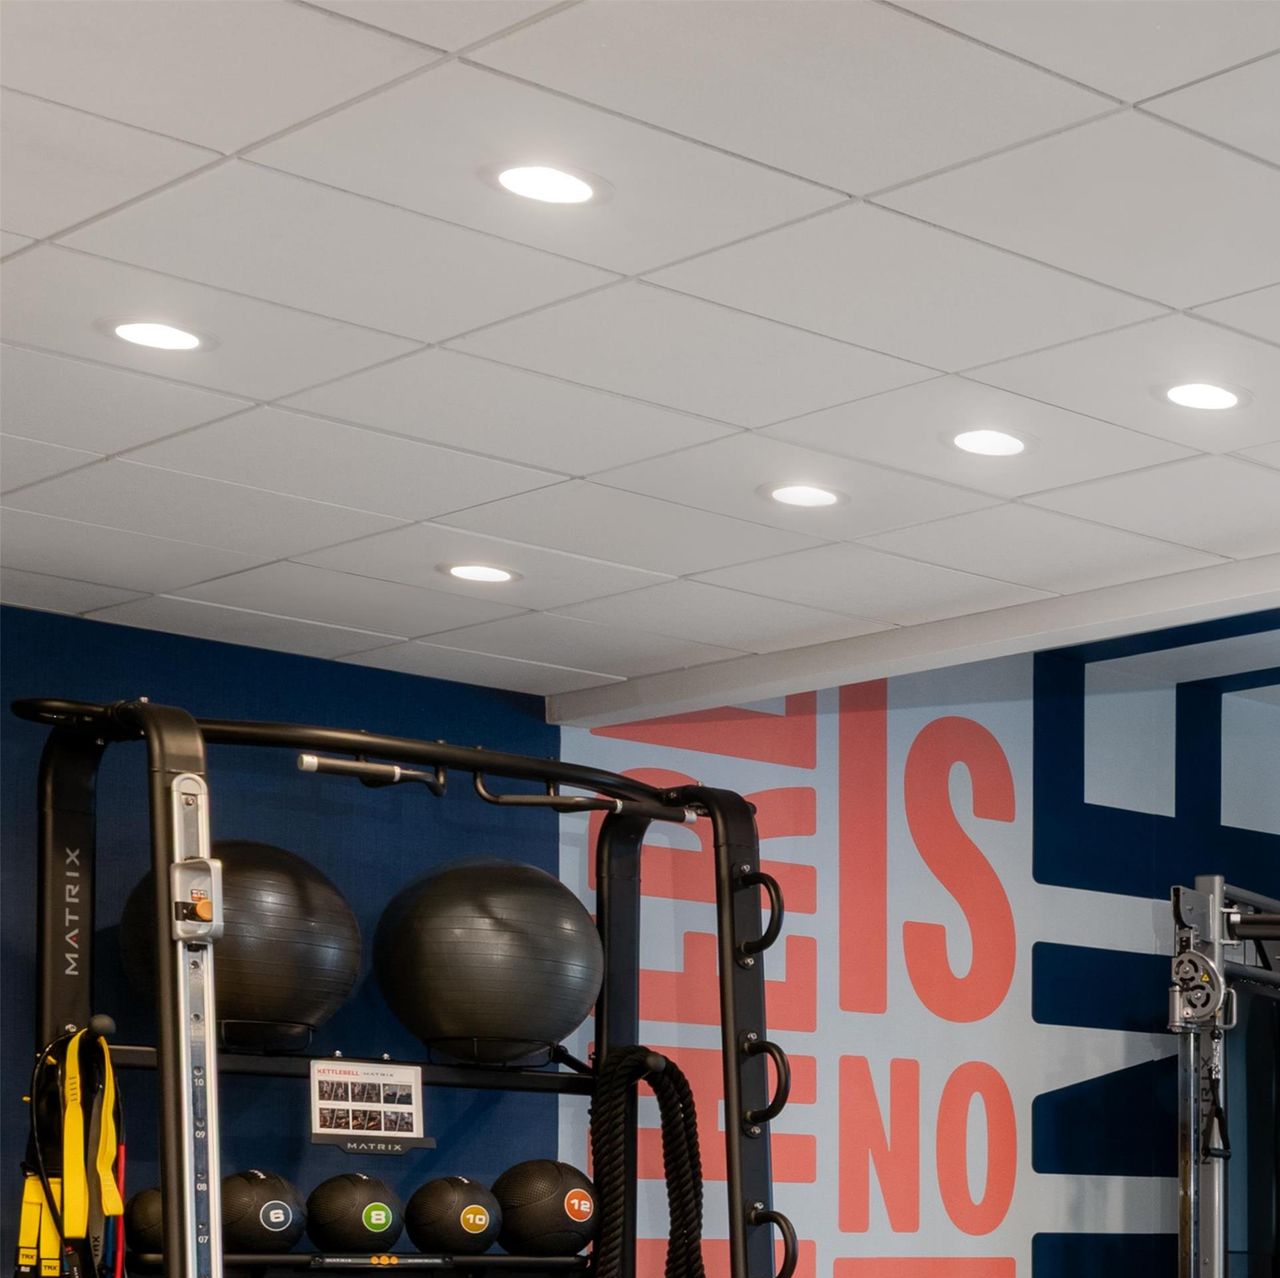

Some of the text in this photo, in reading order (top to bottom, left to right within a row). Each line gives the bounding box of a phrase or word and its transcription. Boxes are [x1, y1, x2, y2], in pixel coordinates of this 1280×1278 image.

[838, 676, 1017, 1024] IS
[65, 847, 80, 976] MATRIX
[316, 1068, 360, 1076] KETTLEBELL
[194, 1078, 204, 1086] 10
[1202, 1056, 1211, 1165] TRIX
[195, 1130, 206, 1138] 09
[347, 1142, 402, 1151] MATRIX
[838, 1054, 1018, 1237] NO
[570, 1198, 591, 1212] 12
[269, 1209, 285, 1223] 6
[370, 1210, 386, 1224] 8
[466, 1214, 487, 1225] 10
[198, 1236, 208, 1244] 07
